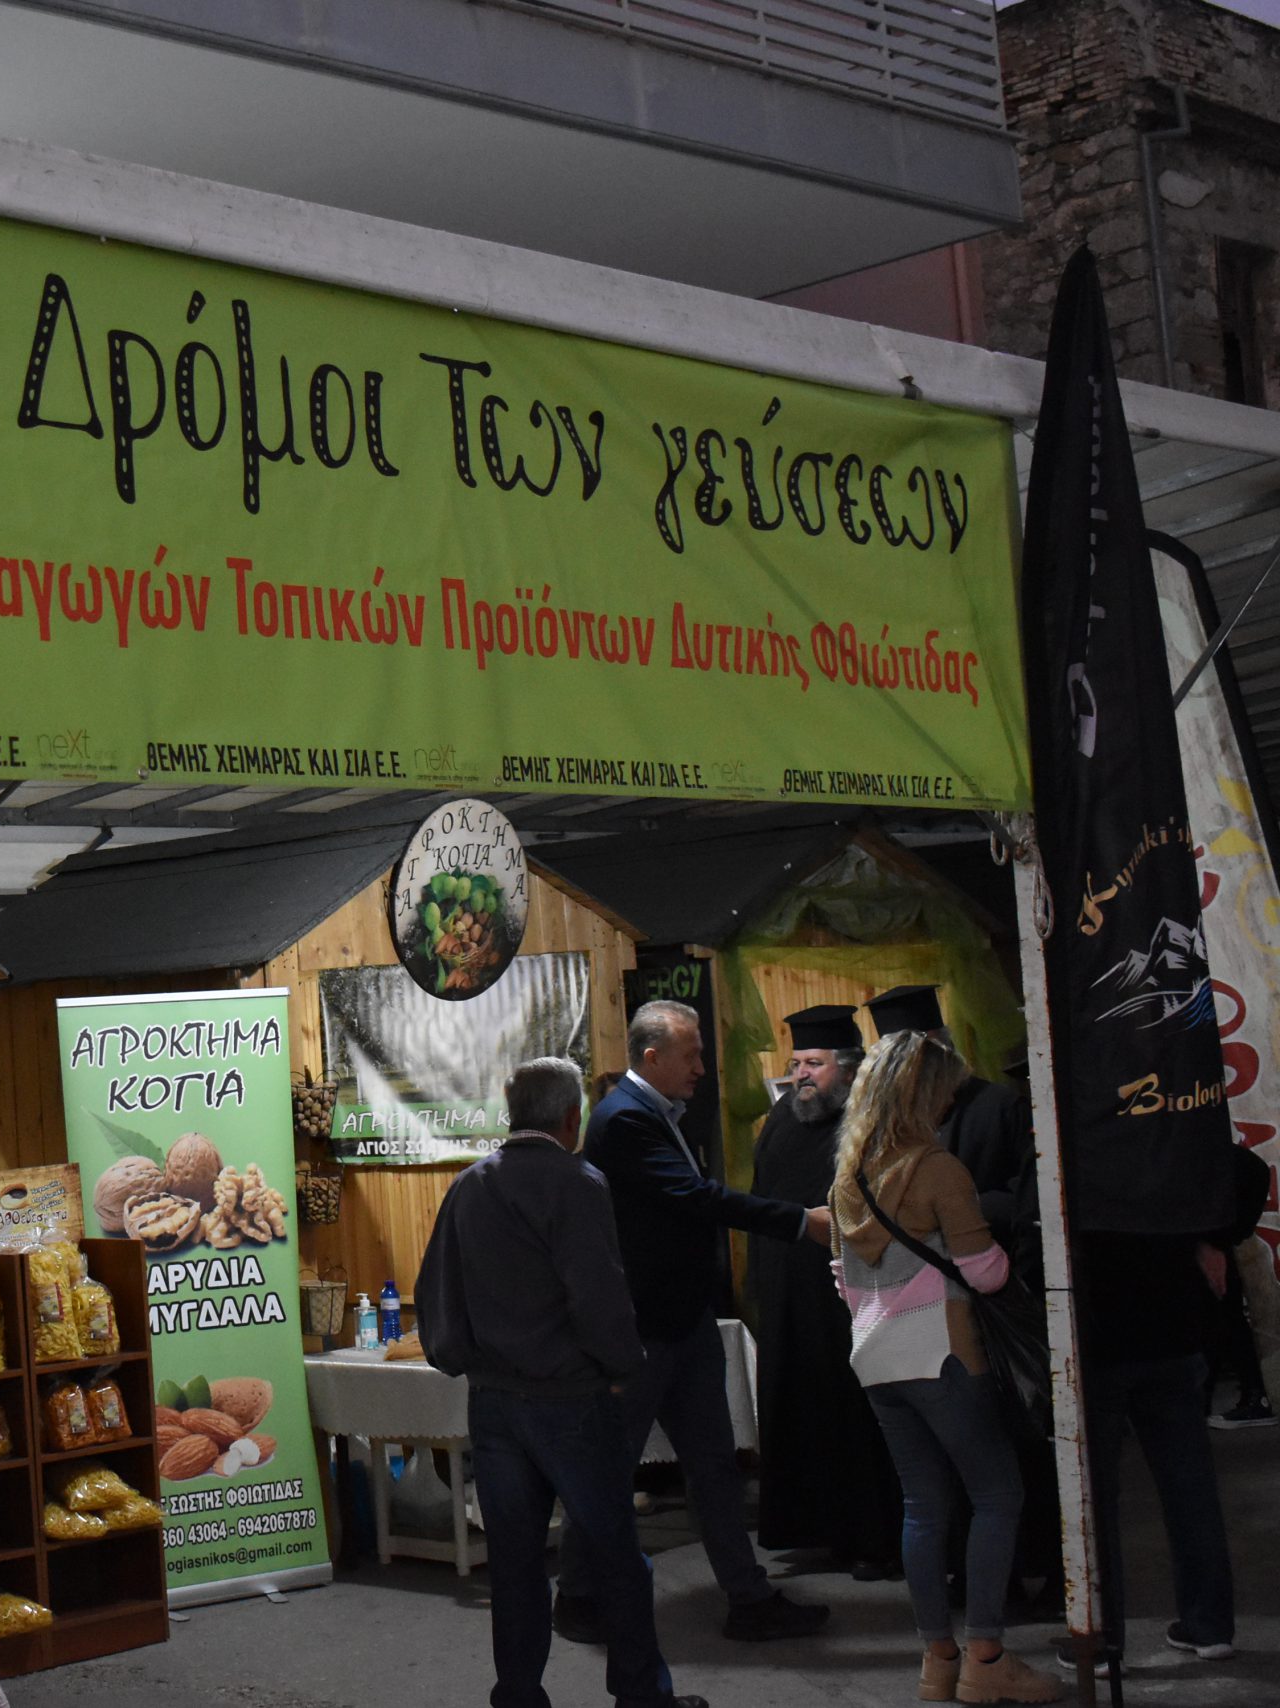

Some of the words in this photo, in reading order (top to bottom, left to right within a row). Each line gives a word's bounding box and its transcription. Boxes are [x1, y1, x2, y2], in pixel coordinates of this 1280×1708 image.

[17, 273, 400, 515] Δρόμοι
[653, 397, 966, 554] γεύσεων
[228, 556, 425, 648] Τοπικών
[442, 576, 654, 670] Προϊόντων
[672, 602, 810, 691] Δυτικής
[812, 622, 978, 706] Φθιώτιδας
[147, 742, 210, 772] ΘΕΜΗΣ
[217, 745, 306, 775] ΧΕΙΜΑΡΑΣ
[309, 748, 339, 776] ΚΑΙ
[346, 750, 370, 778] ΣΙΑ
[375, 750, 406, 778] Ε.Ε.
[501, 755, 550, 782] ΘΕΜΗΣ
[556, 758, 628, 786] ΧΕΙΜΑΡΑΣ
[631, 761, 656, 787] ΚΑΙ
[660, 762, 680, 788] ΣΙΑ
[683, 763, 708, 789] Ε.Ε.
[783, 768, 821, 791] ΘΕΜΗΣ
[827, 770, 886, 796] ΧΕΙΜΑΡΑΣ
[889, 774, 908, 797] ΚΑΙ
[911, 774, 930, 798] ΣΙΑ
[934, 776, 955, 799] Ε.Ε.
[397, 805, 526, 917] ΑΓΡΟΚΤΗΜΑ
[433, 843, 493, 872] ΚΟΓΙΑ
[70, 1018, 281, 1068] ΑΓΡΟΚΤΗΜΑ
[109, 1069, 245, 1112] ΚΟΓΙΑ
[342, 1107, 486, 1134] ΑΓΡΟΚΤΗΜΑ
[356, 1141, 400, 1156] ΑΓΙΟΣ
[170, 1489, 224, 1515] ΣΩΣΤΗΣ
[225, 1479, 304, 1507] ΦΘΙΩΤΙΔΑΣ
[188, 1520, 228, 1545] 43064
[237, 1508, 317, 1538] 6942067878
[167, 1540, 313, 1574] ogiasnikos@gmail.com
